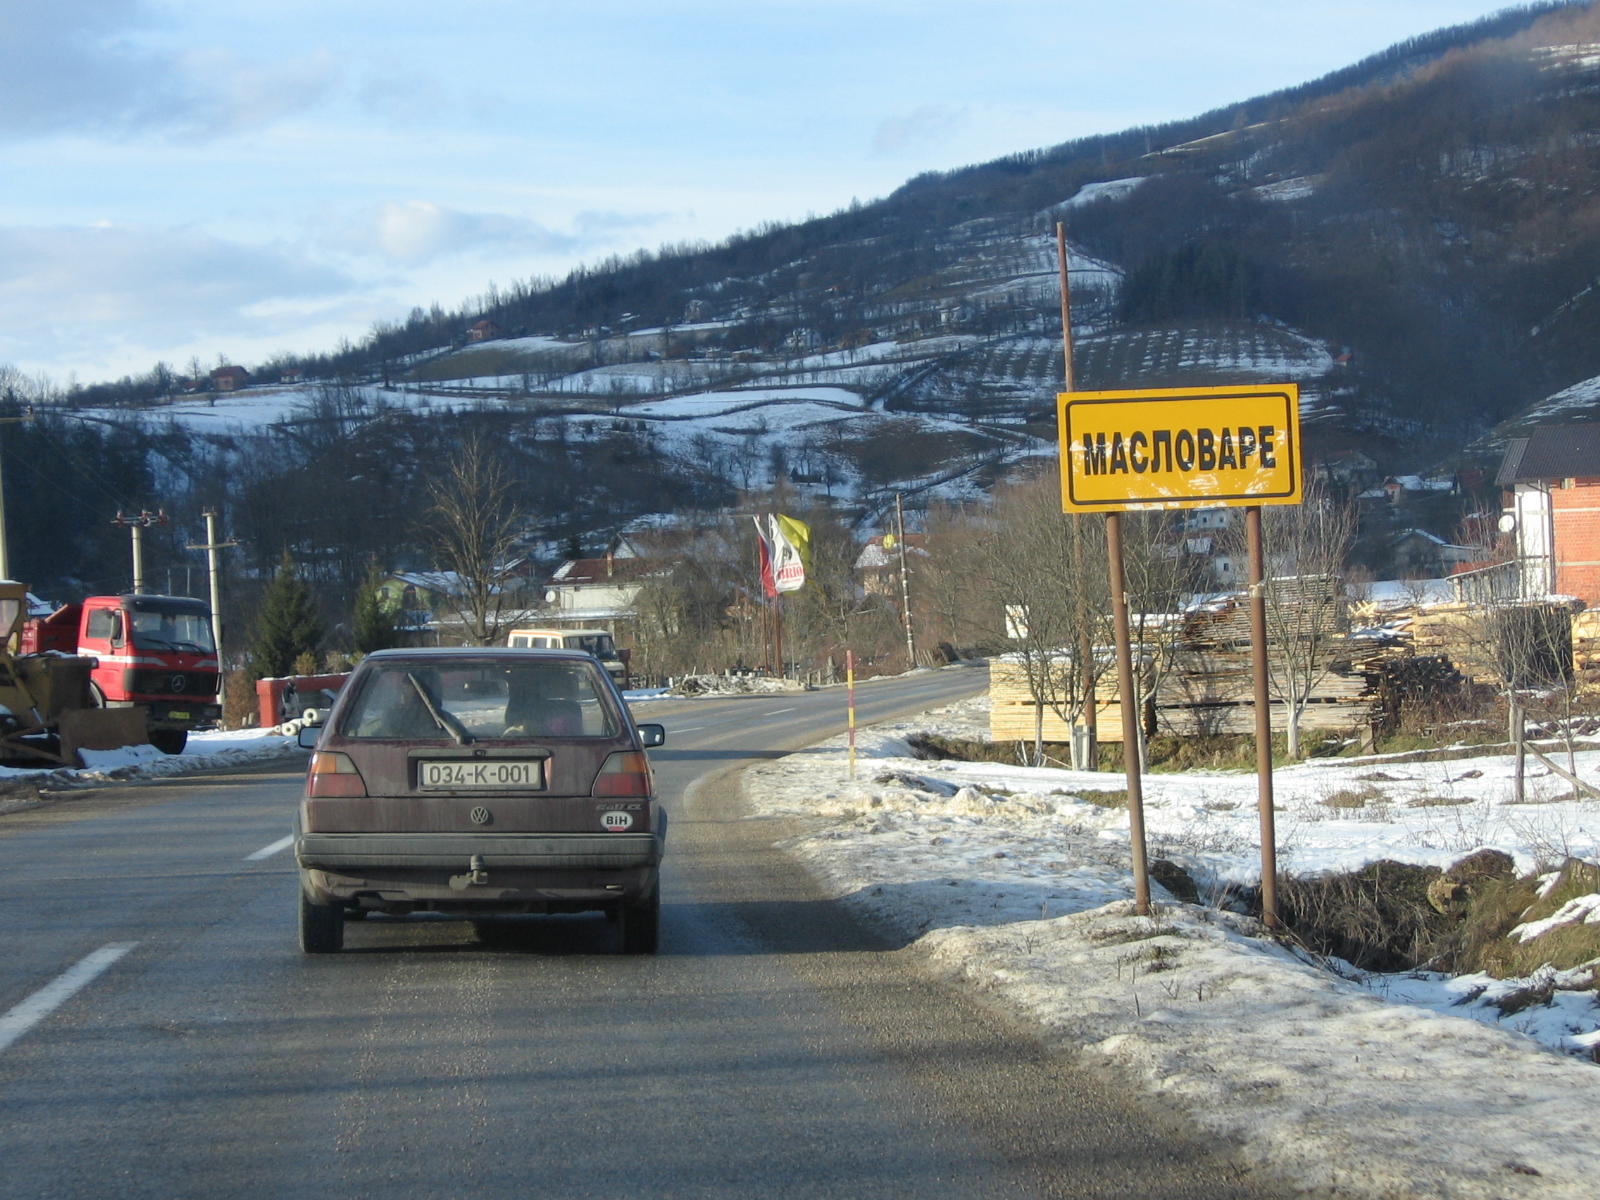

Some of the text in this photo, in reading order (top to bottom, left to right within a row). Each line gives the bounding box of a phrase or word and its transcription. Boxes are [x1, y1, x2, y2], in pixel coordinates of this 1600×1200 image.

[1083, 425, 1276, 475] МАСЛОВАРЕ
[429, 764, 530, 784] 034-K-001
[606, 815, 628, 825] BiH
